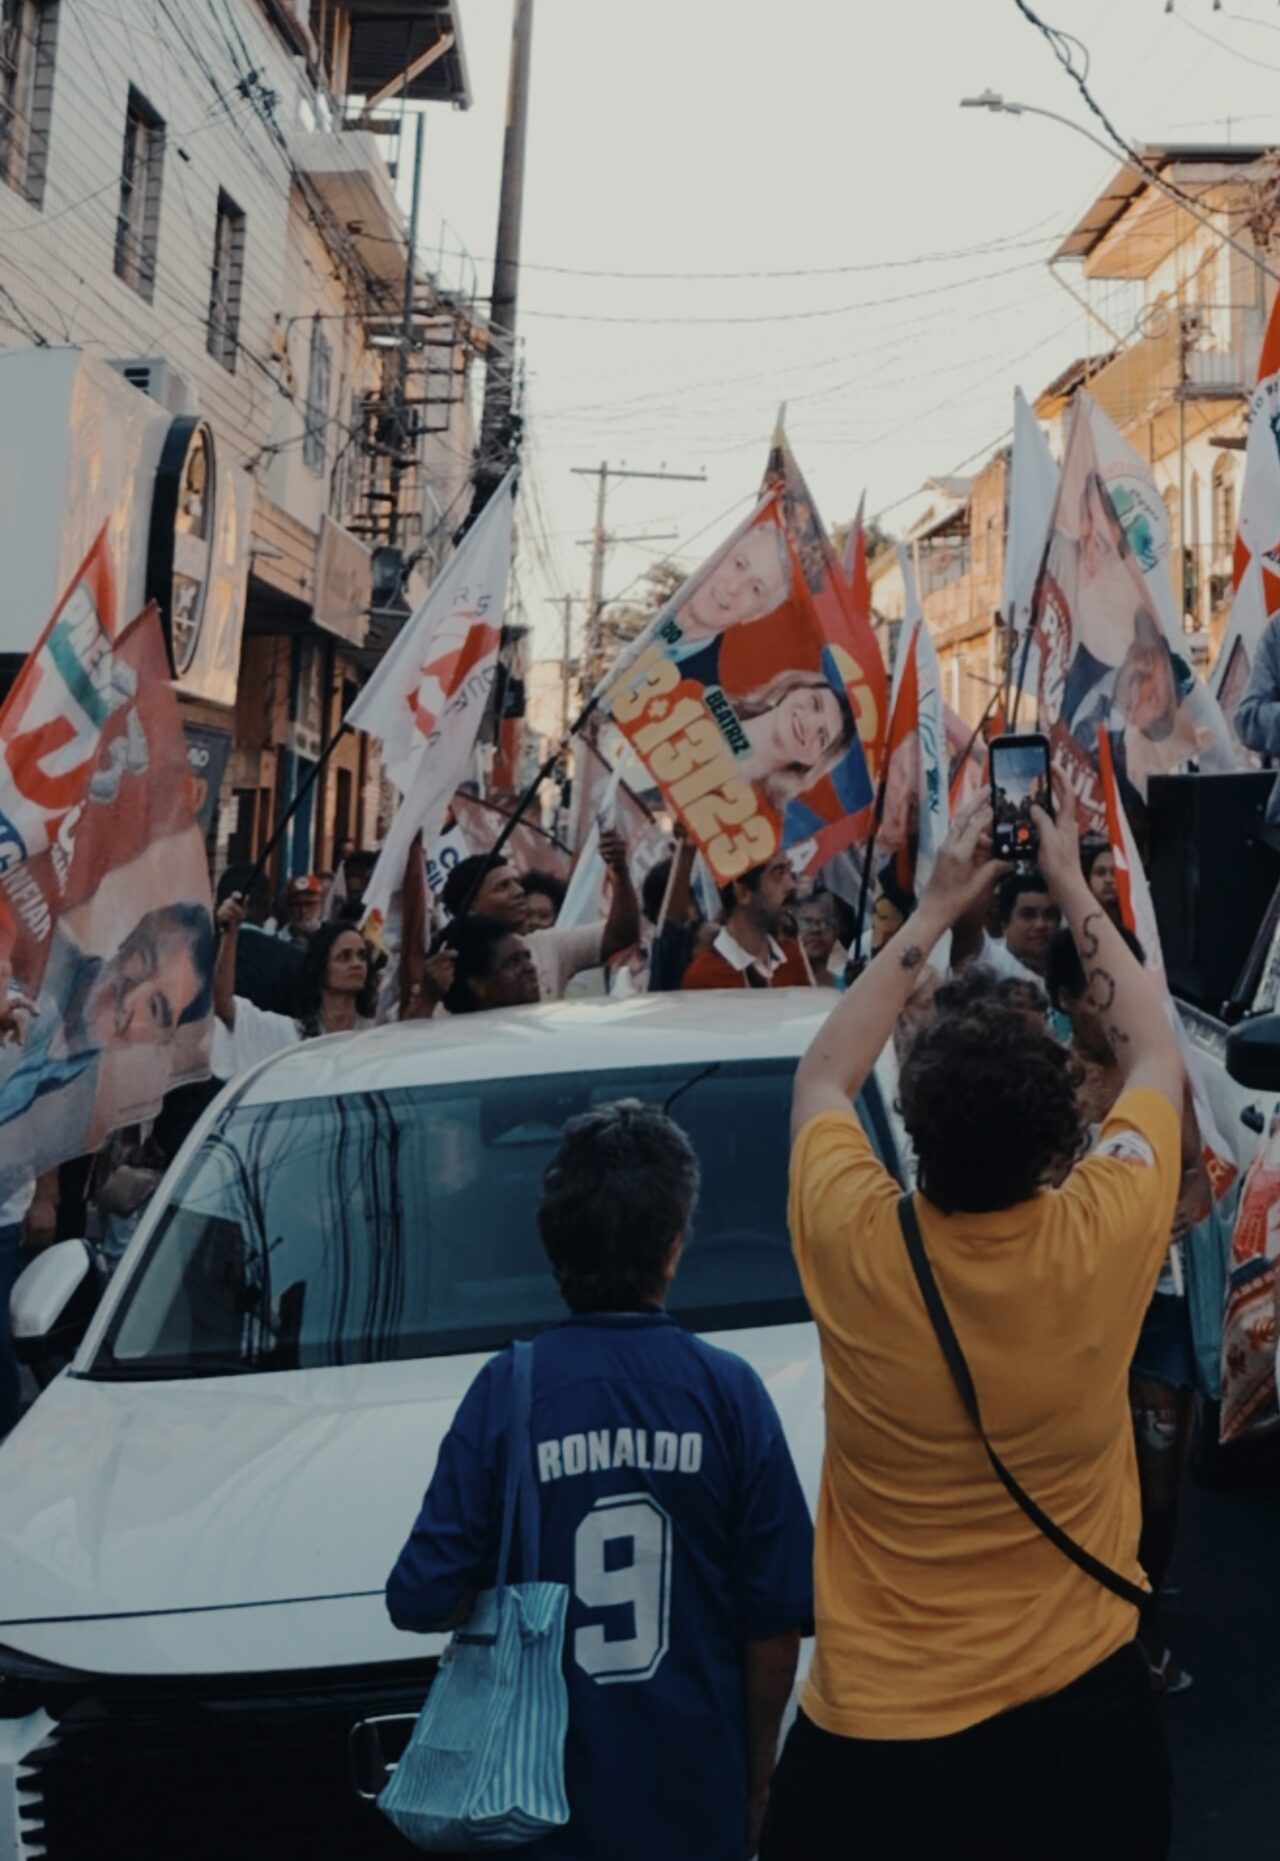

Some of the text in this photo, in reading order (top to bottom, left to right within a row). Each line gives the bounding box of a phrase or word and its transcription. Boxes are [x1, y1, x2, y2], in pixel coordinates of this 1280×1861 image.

[705, 691, 750, 755] BEATRIZ
[538, 1428, 702, 1483] RONALDO
[574, 1491, 672, 1685] 9
